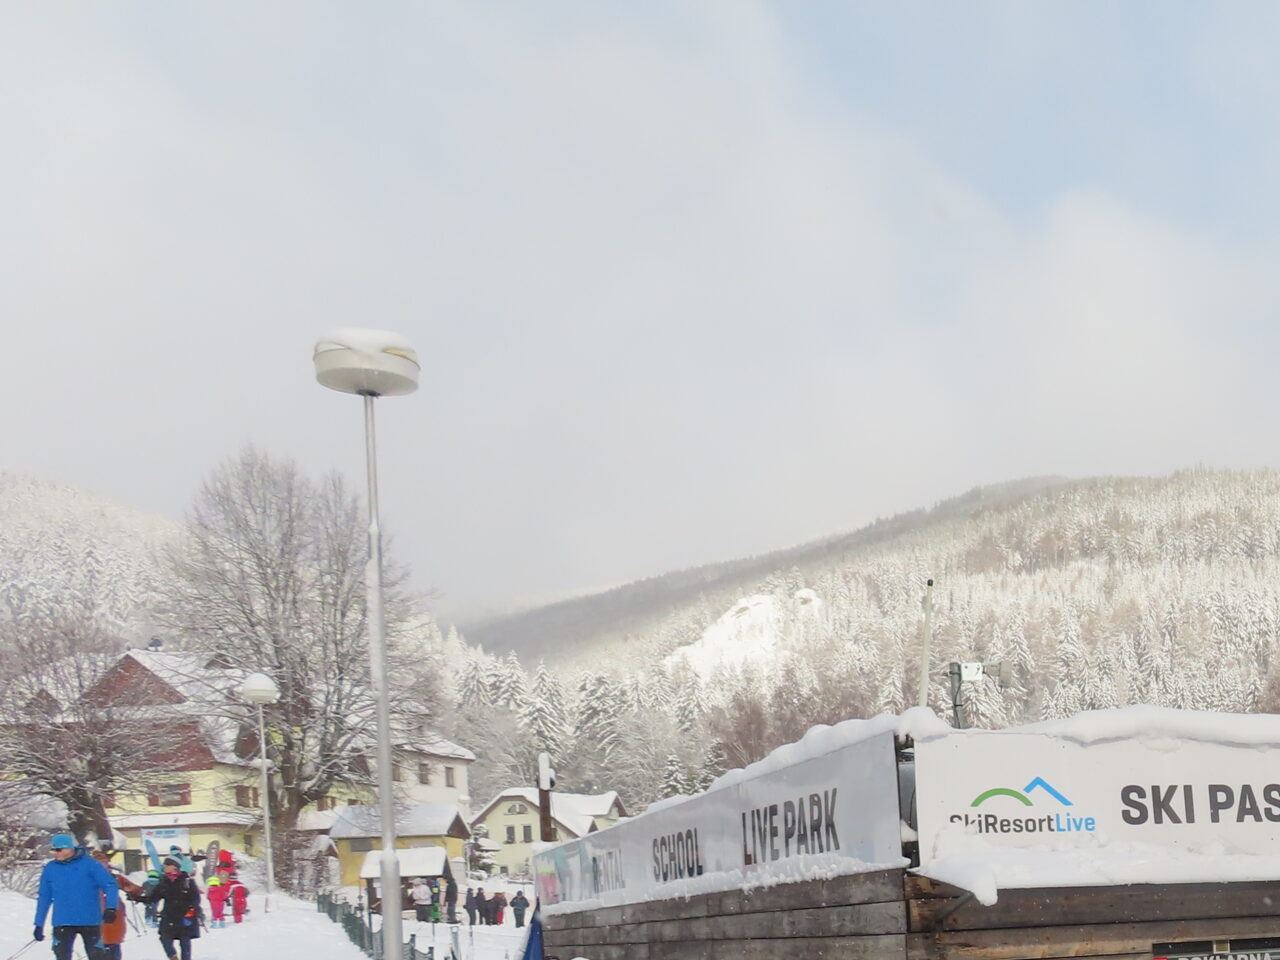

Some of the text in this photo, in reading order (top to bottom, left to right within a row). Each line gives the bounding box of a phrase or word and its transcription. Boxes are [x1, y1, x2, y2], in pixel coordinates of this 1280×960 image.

[742, 788, 841, 866] LIVE PARK
[1121, 784, 1196, 825] SKI
[652, 827, 704, 882] SCHOOL
